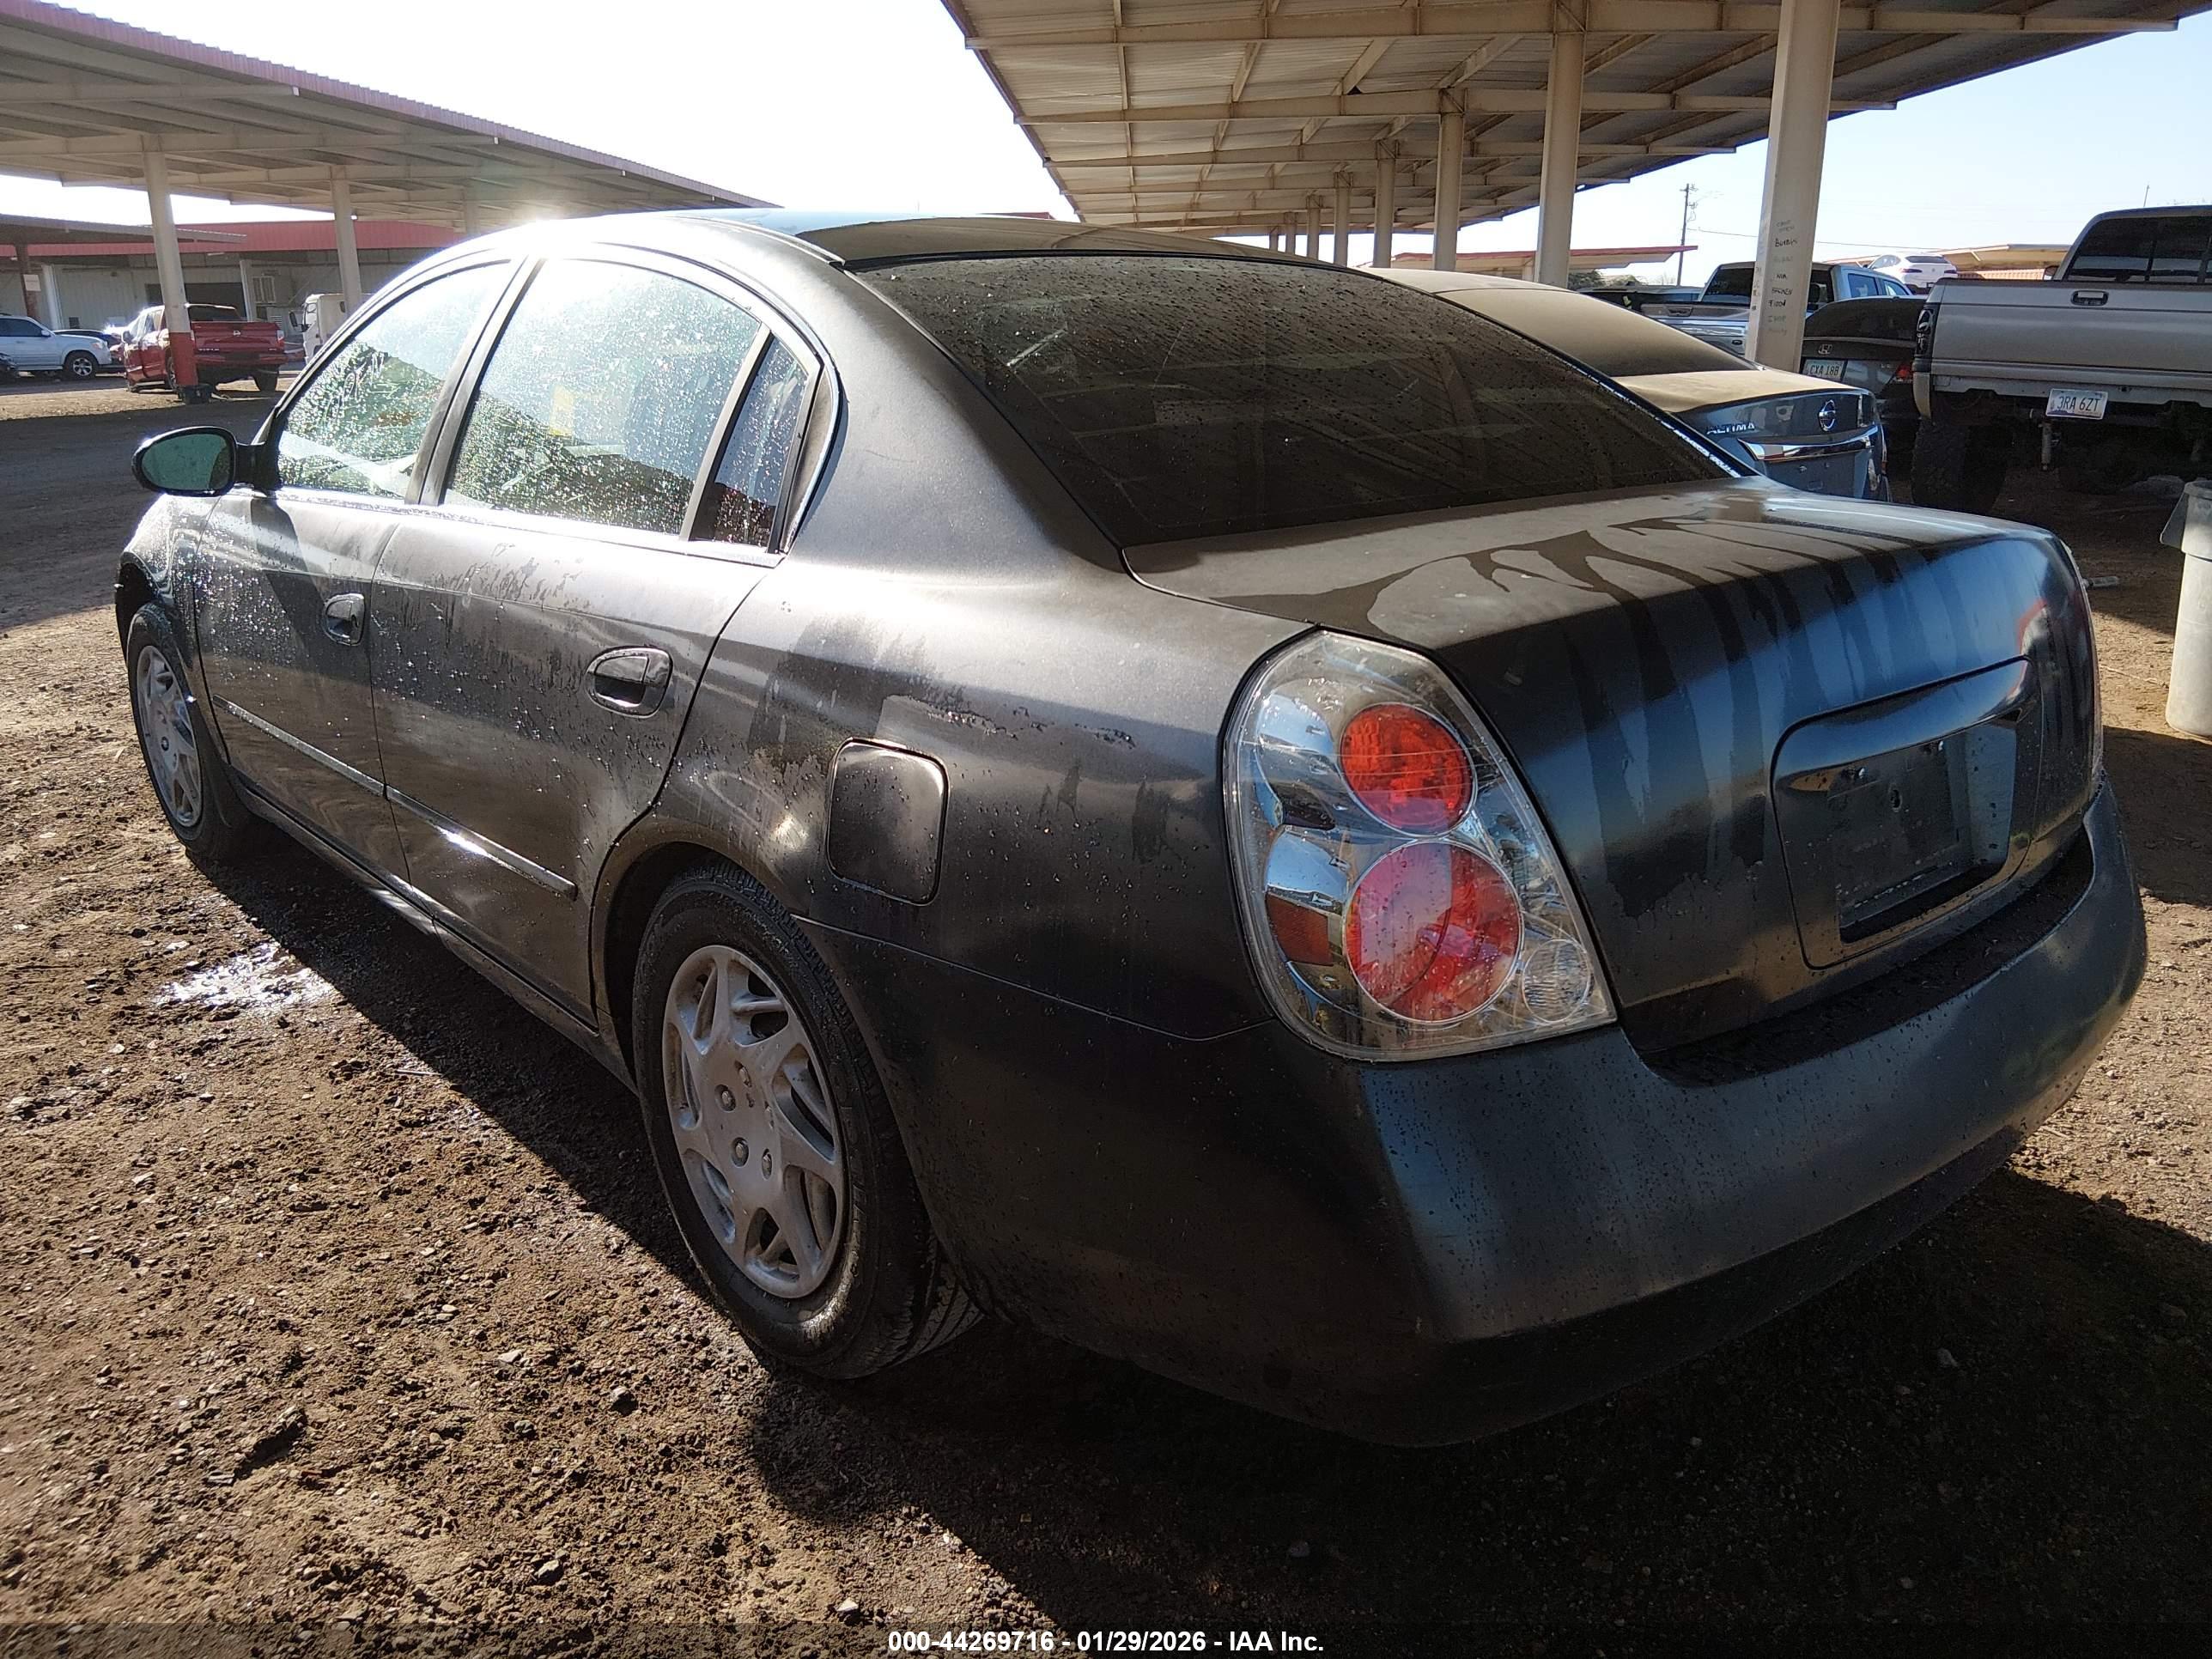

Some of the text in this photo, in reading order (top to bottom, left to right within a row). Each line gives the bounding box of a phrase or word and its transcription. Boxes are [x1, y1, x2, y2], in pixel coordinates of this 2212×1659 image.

[2057, 395, 2101, 411] 3RA 6ZT
[1706, 419, 1755, 435] ALTIMA
